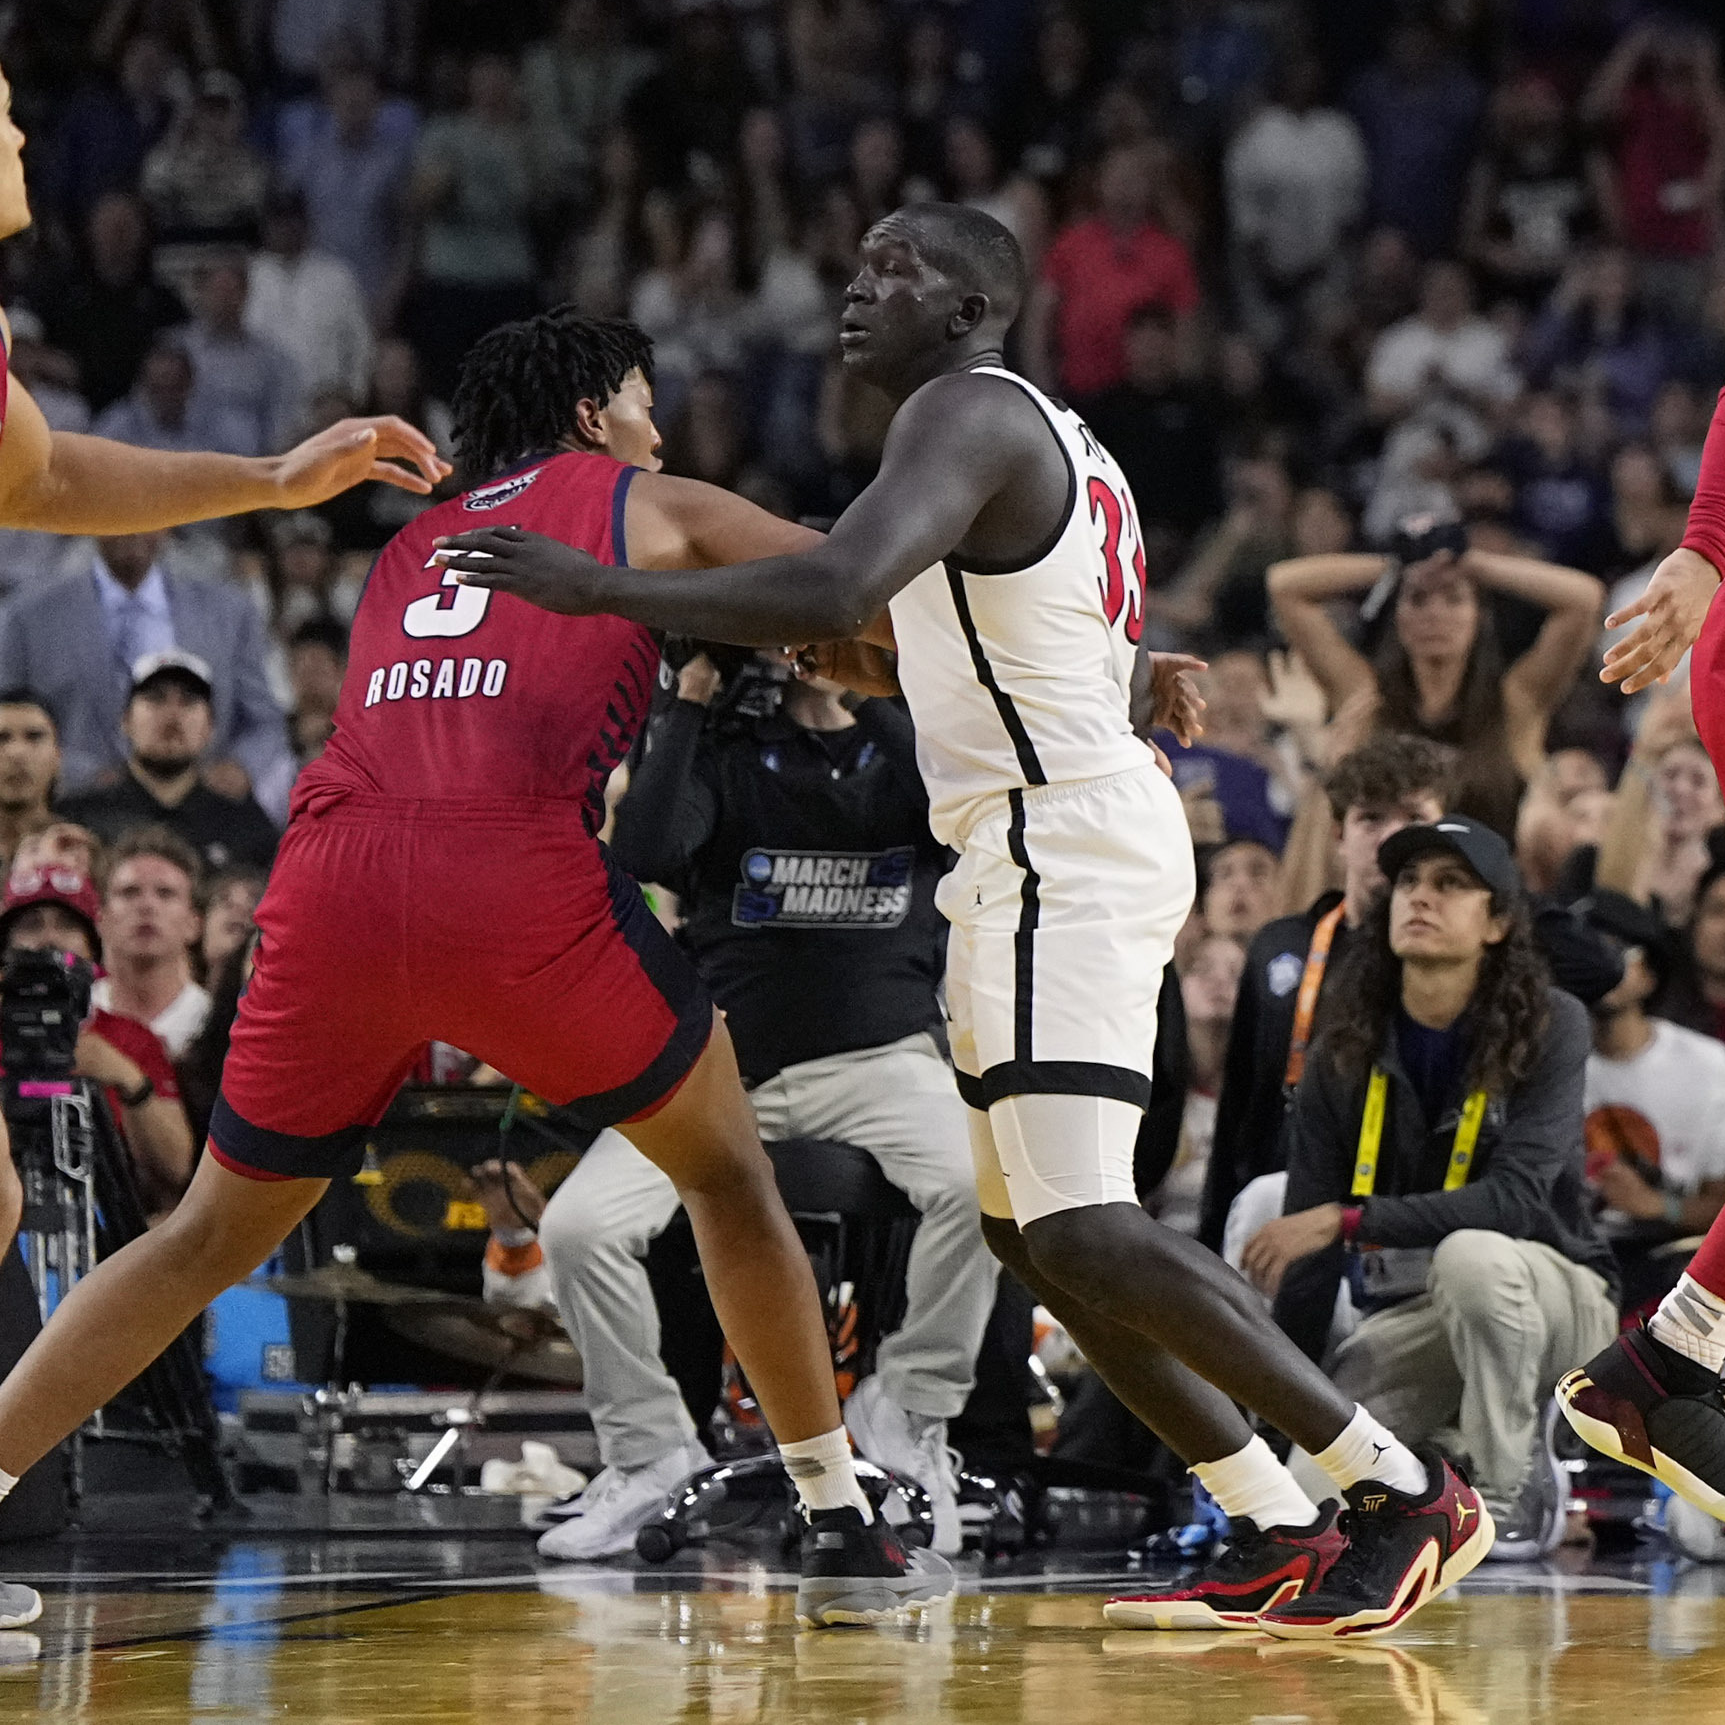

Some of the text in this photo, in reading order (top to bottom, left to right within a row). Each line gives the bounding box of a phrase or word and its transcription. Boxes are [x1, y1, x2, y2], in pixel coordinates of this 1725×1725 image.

[364, 657, 508, 708] ROSADO
[771, 857, 871, 885] MARCH
[782, 885, 909, 915] MADNESS
